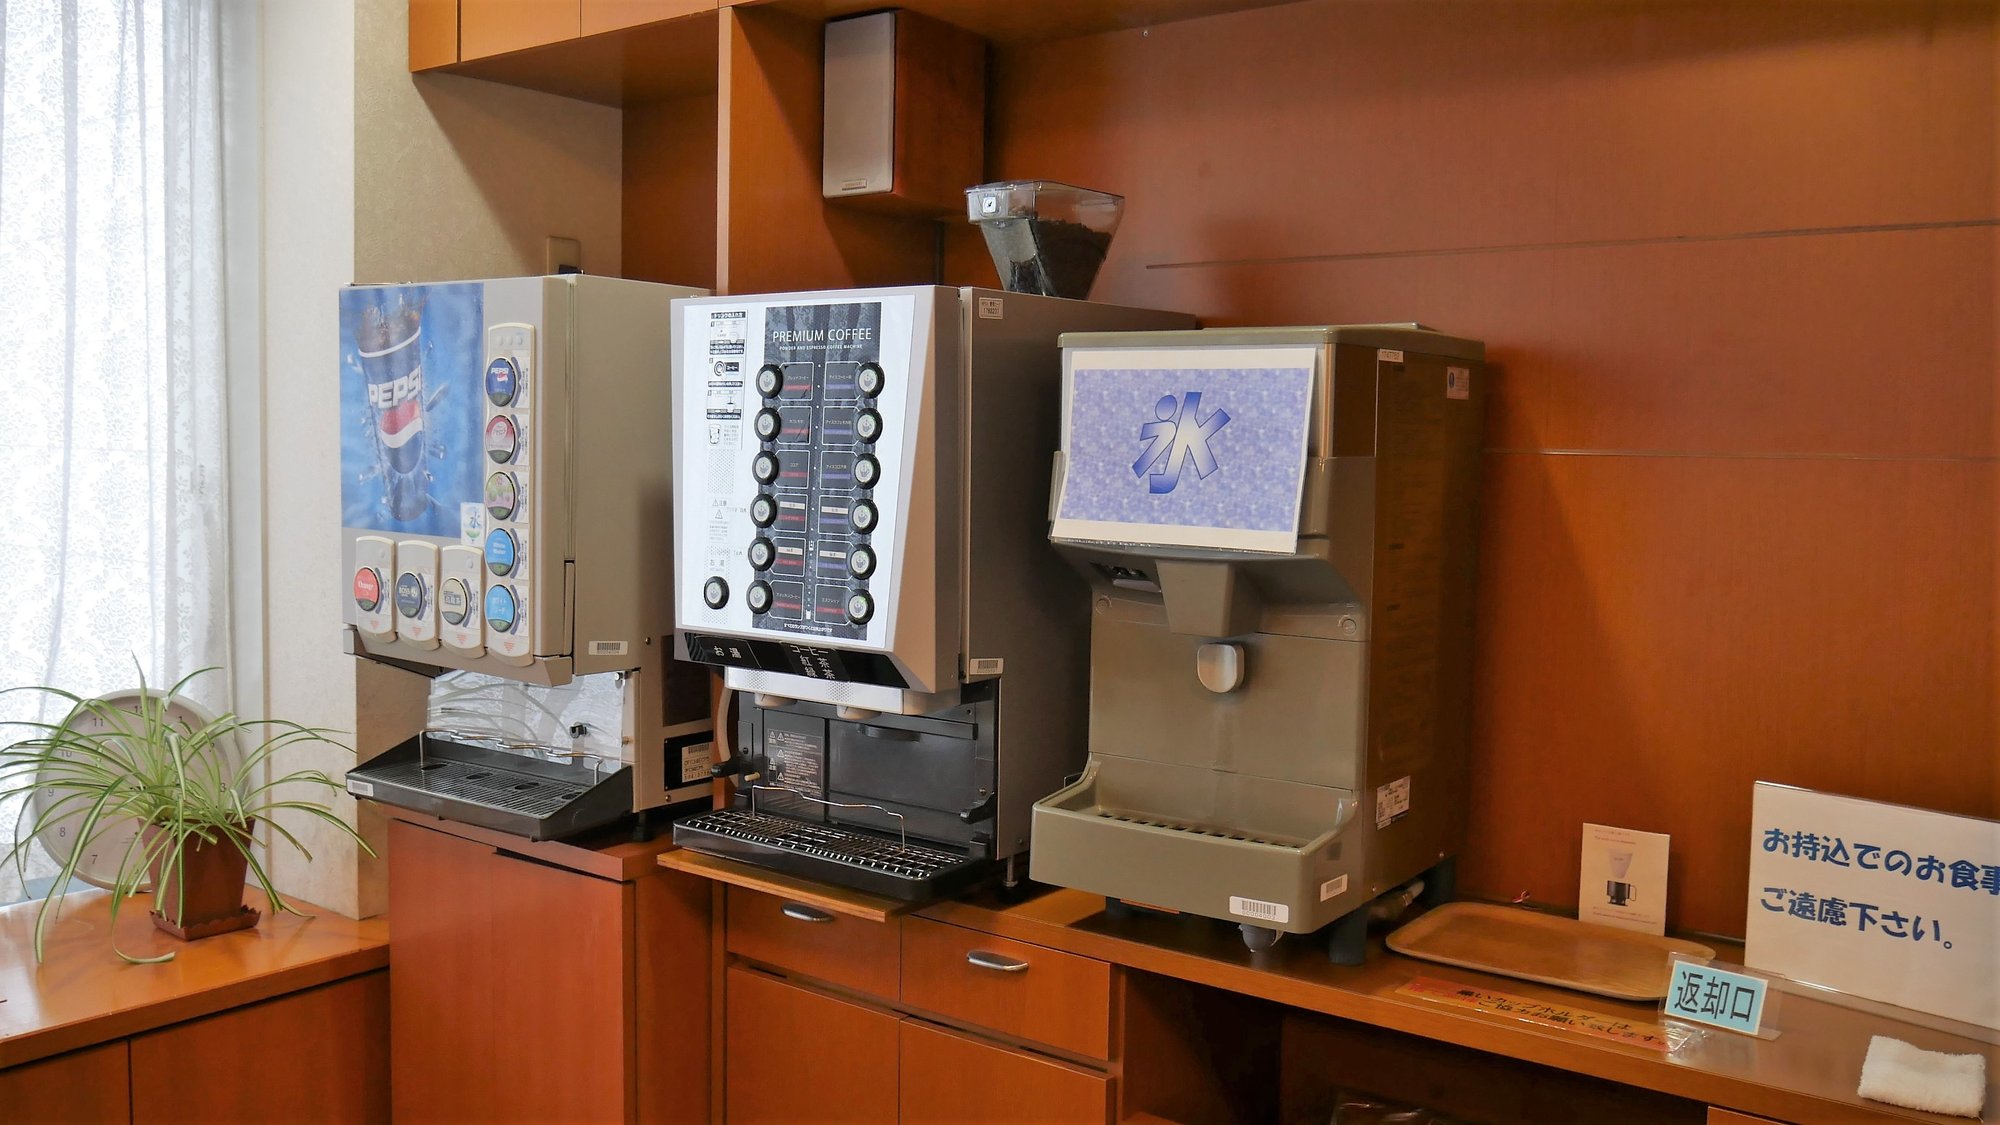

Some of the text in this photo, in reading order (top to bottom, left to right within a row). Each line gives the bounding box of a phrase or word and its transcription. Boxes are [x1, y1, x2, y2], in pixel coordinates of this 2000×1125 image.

[772, 328, 872, 342] PREMIUM COFFEE
[491, 367, 509, 375] PEPSI
[1131, 391, 1231, 494] 氷
[789, 645, 829, 656] コーヒー
[800, 655, 831, 668] 紅茶
[92, 717, 104, 727] 11
[220, 782, 227, 793] 3
[59, 827, 66, 838] 8
[91, 854, 98, 865] 7
[1762, 828, 2000, 896] お持込でのお食事
[1760, 887, 1953, 950] ご遠慮下さい。
[1674, 970, 1755, 1023] 返却口
